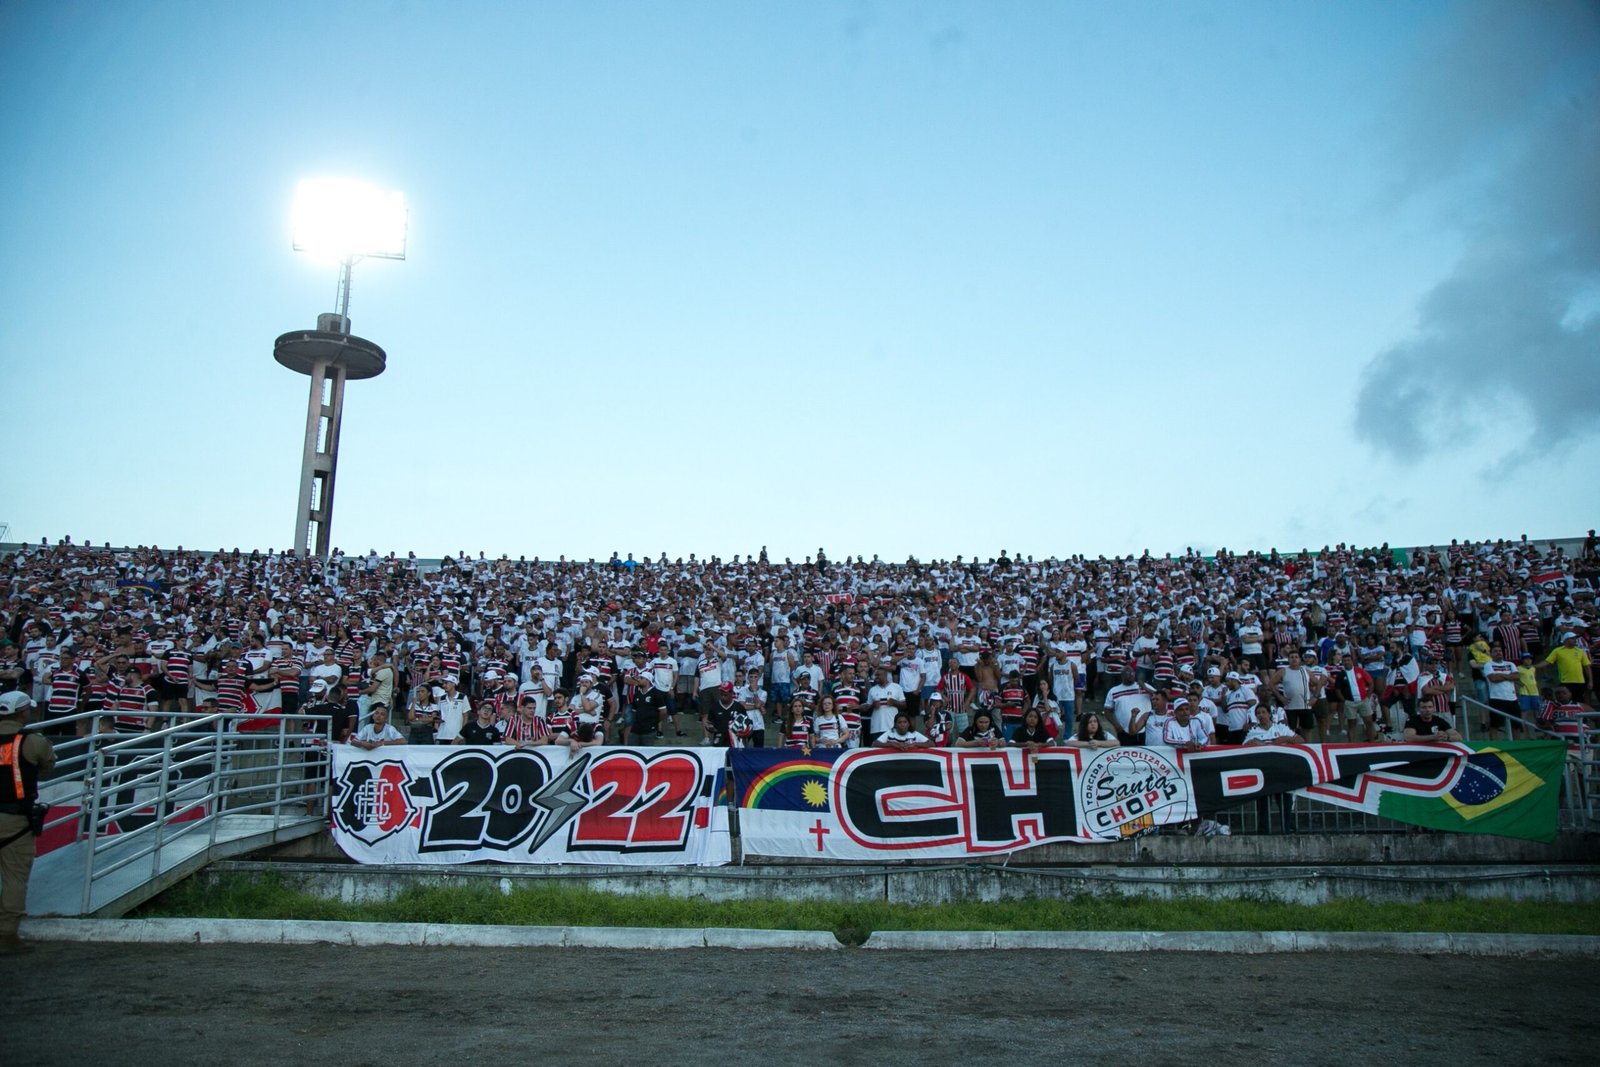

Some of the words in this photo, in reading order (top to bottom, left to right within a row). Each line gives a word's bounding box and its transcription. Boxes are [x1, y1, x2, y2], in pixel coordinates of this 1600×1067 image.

[1086, 763, 1104, 805] TORCIDA
[1096, 775, 1169, 801] Santa
[1097, 784, 1177, 827] CHOPP
